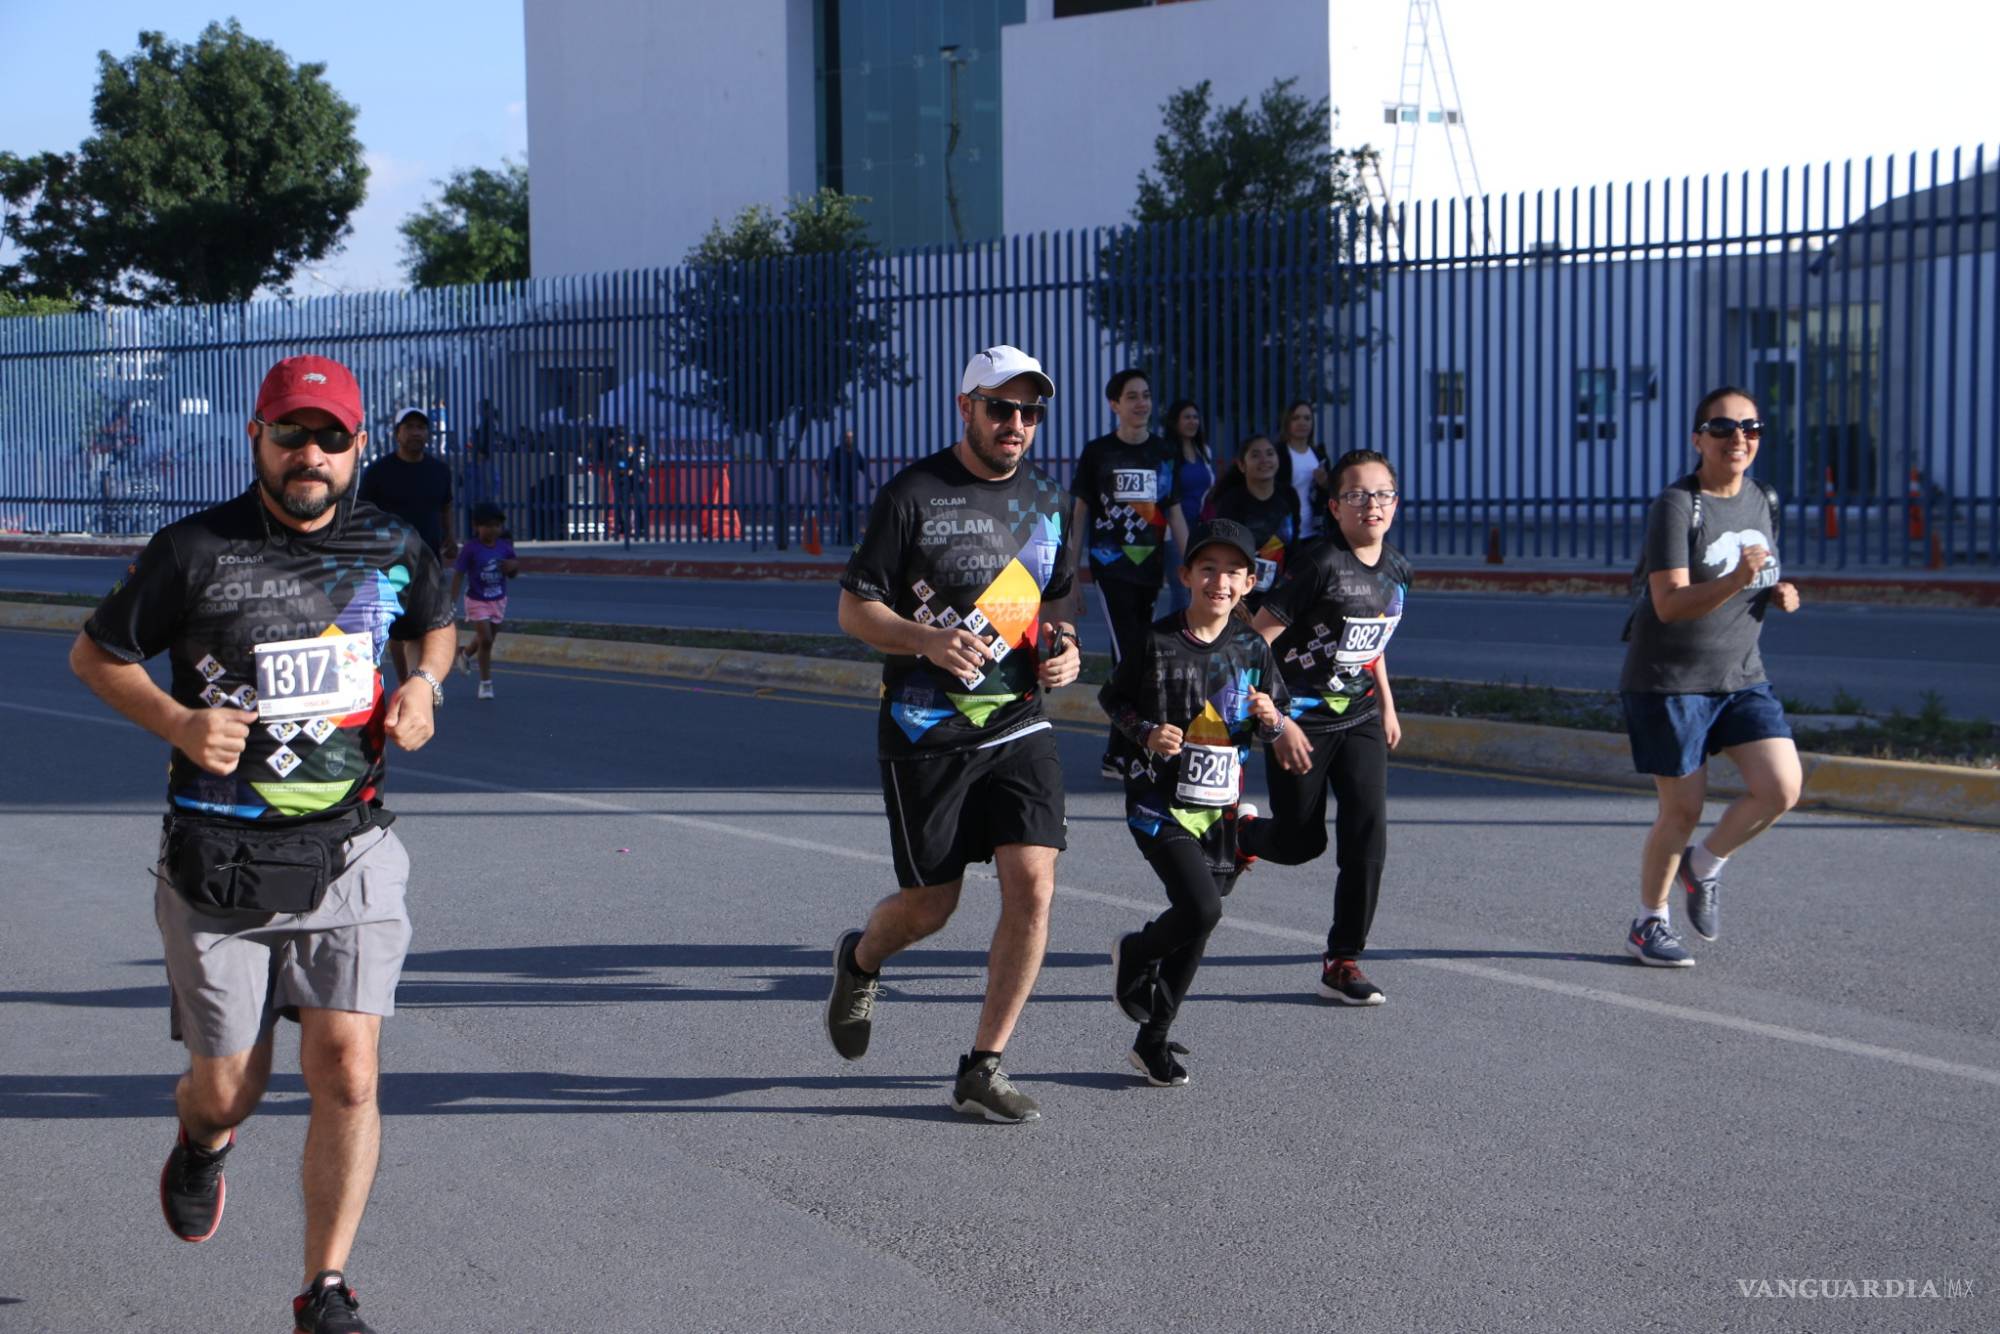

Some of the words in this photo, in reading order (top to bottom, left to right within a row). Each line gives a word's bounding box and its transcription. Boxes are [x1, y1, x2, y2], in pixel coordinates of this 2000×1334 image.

[1115, 473, 1140, 491] 973
[930, 497, 967, 506] COLAM
[922, 519, 994, 536] COLAM
[218, 555, 264, 565] COLAM
[205, 579, 301, 601] COLAM
[1346, 625, 1381, 650] 982
[261, 650, 331, 697] 1317
[1187, 751, 1228, 786] 529
